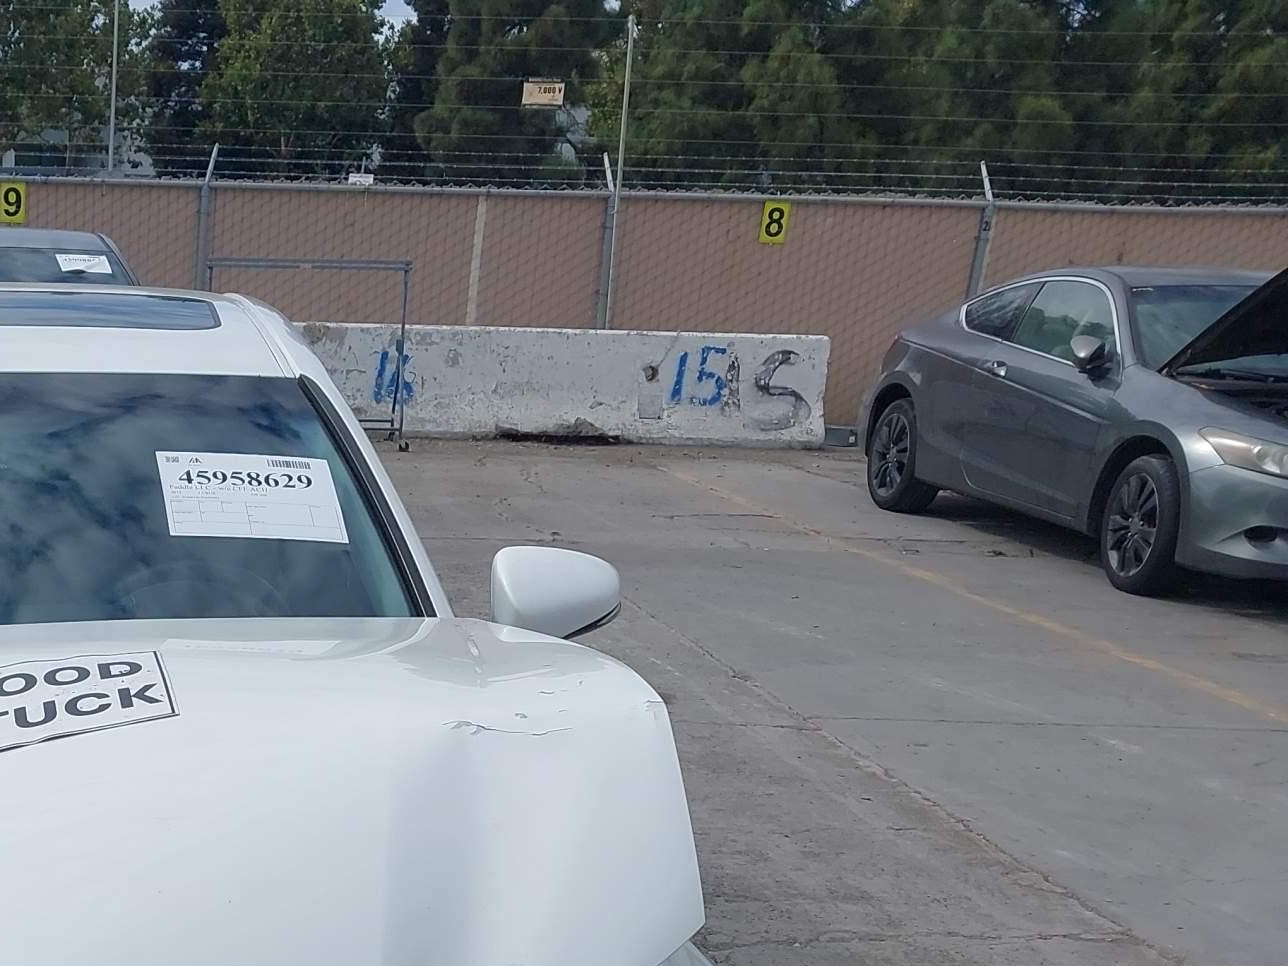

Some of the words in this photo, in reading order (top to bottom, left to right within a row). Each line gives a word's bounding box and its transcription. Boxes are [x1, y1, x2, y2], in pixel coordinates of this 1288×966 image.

[538, 87, 557, 95] 7,000
[559, 87, 563, 95] V
[3, 187, 22, 217] 9
[765, 207, 785, 237] 8
[671, 345, 728, 407] 15
[178, 469, 313, 490] 45958629
